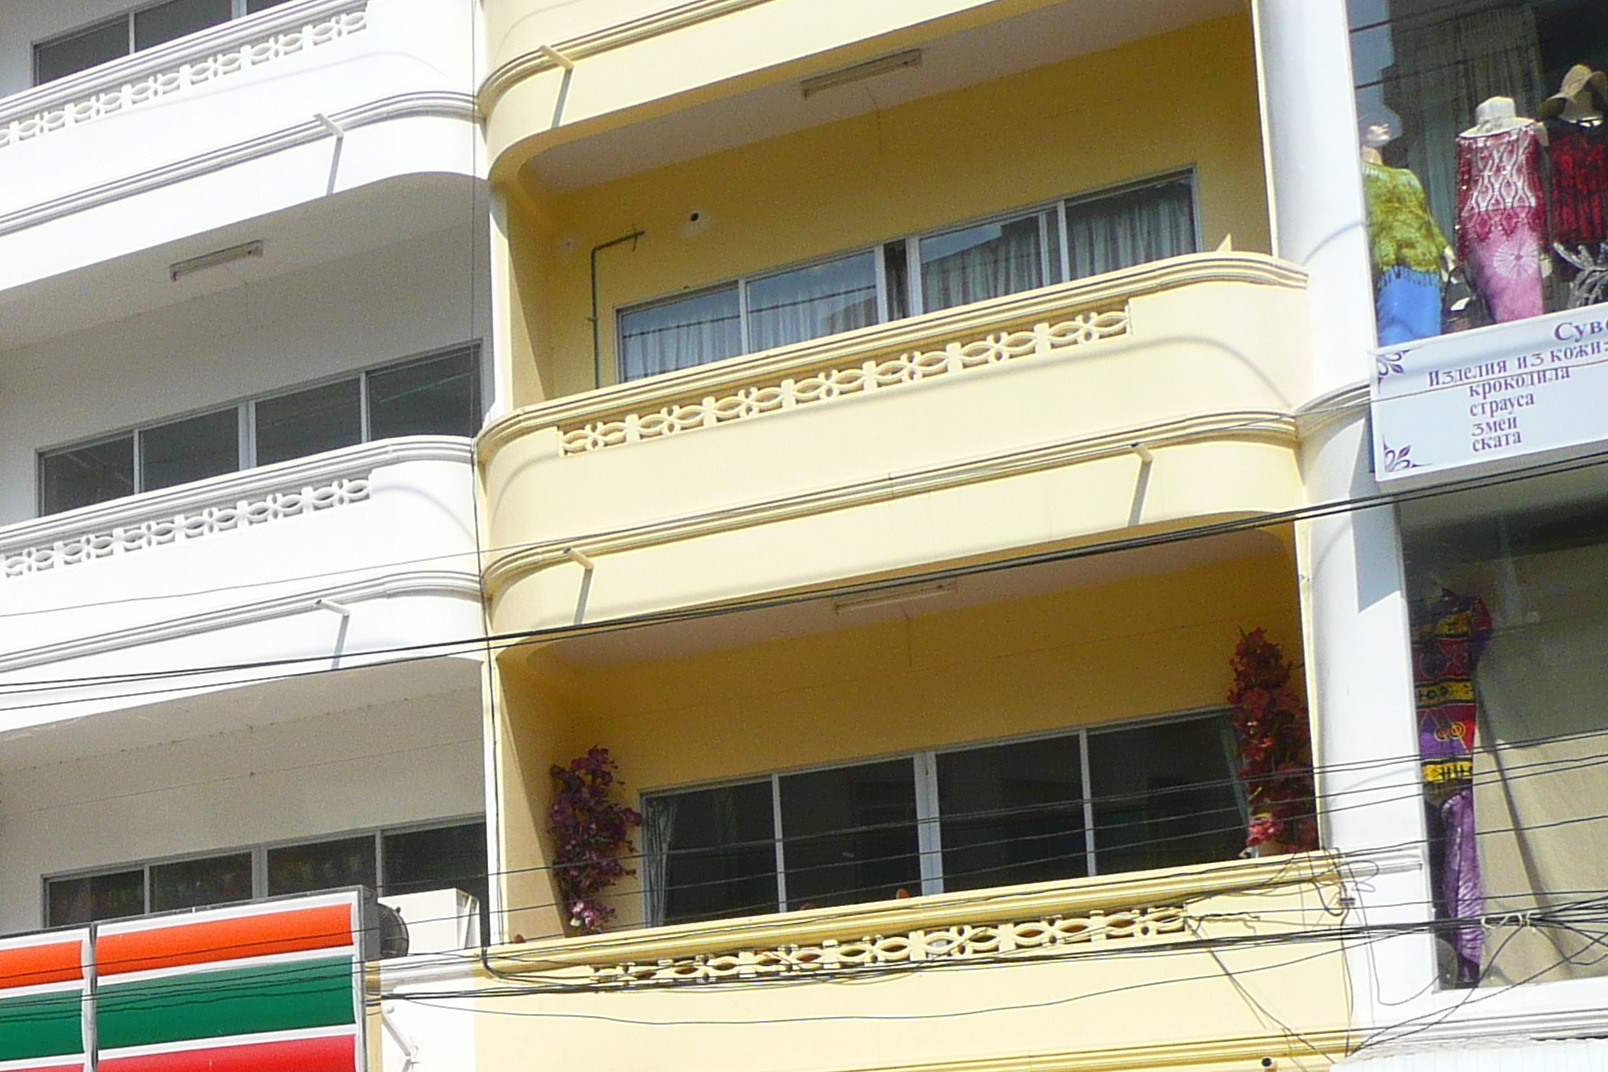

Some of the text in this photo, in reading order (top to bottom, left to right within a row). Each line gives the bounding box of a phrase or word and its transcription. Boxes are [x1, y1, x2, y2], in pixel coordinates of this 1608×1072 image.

[1554, 319, 1608, 343] Сув
[1428, 359, 1508, 387] Изделия
[1517, 352, 1545, 369] из
[1469, 366, 1572, 399] крокодила
[1469, 392, 1535, 418] страуса
[1472, 430, 1522, 452] ската
